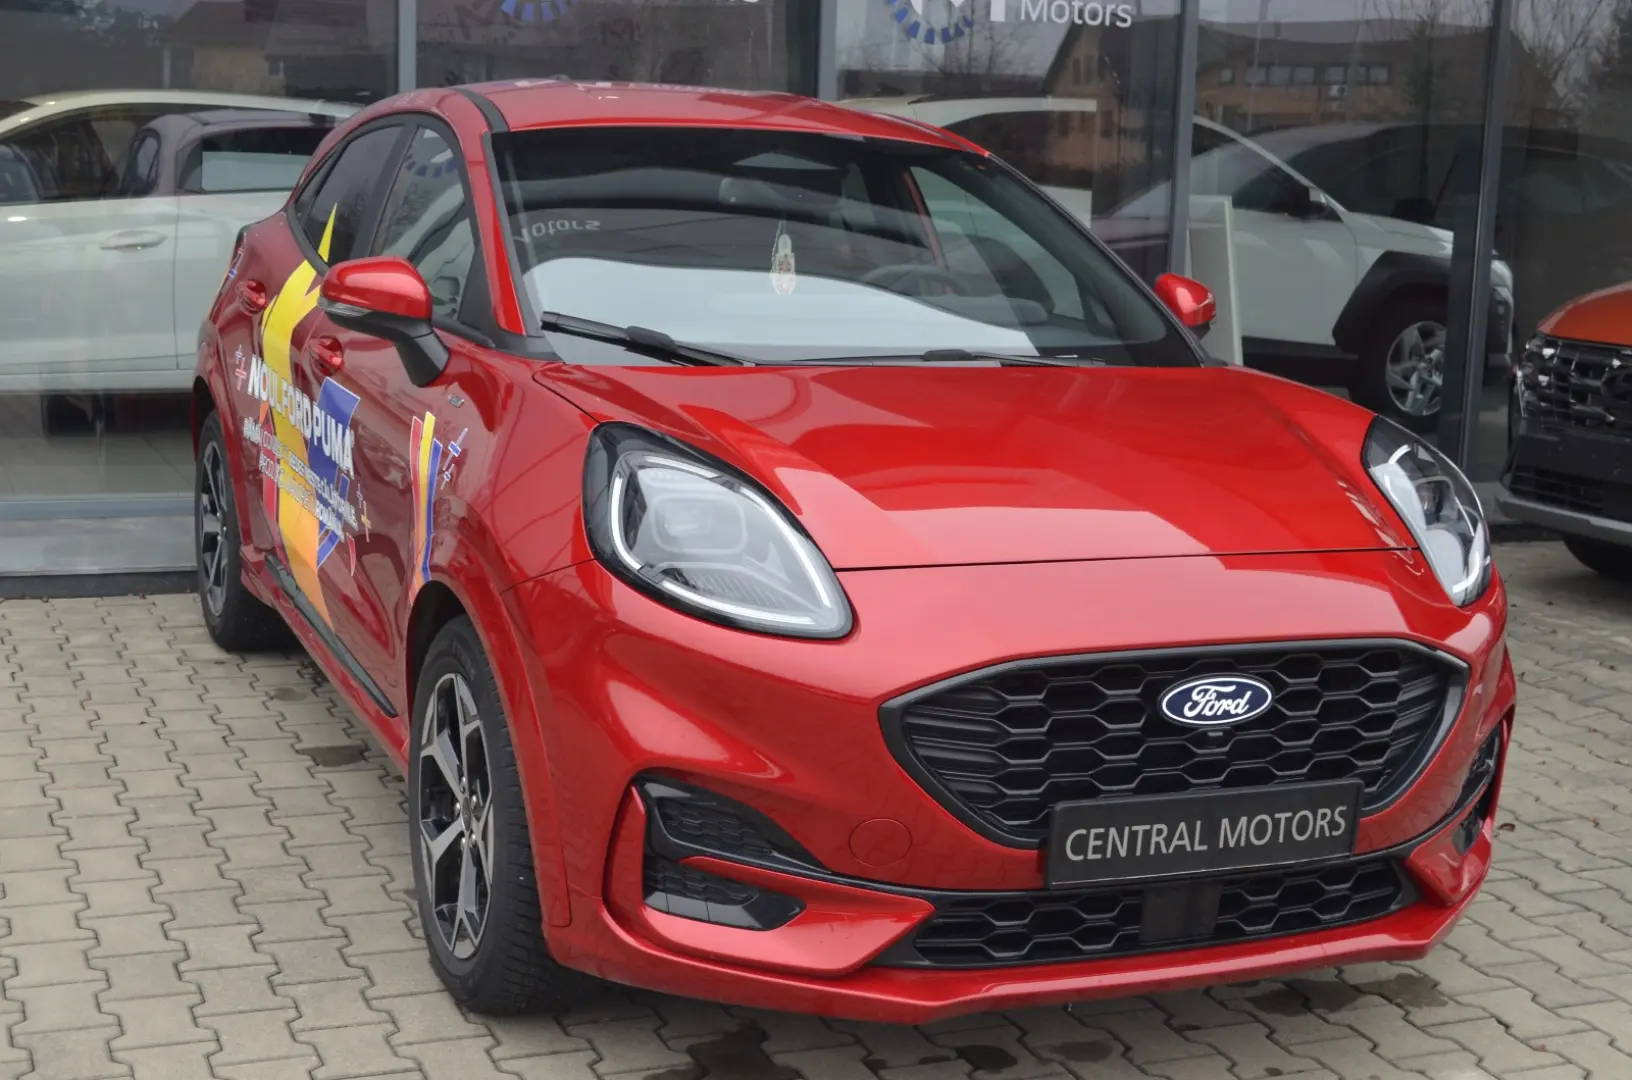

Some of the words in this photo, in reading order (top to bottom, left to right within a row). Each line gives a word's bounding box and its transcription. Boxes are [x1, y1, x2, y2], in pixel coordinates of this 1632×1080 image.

[1020, 0, 1132, 28] Motors
[247, 354, 283, 414] NOUL
[282, 377, 312, 440] FORD
[1183, 684, 1250, 718] Ford
[1065, 819, 1208, 862] CENTRAL
[1218, 806, 1348, 850] MOTORS
